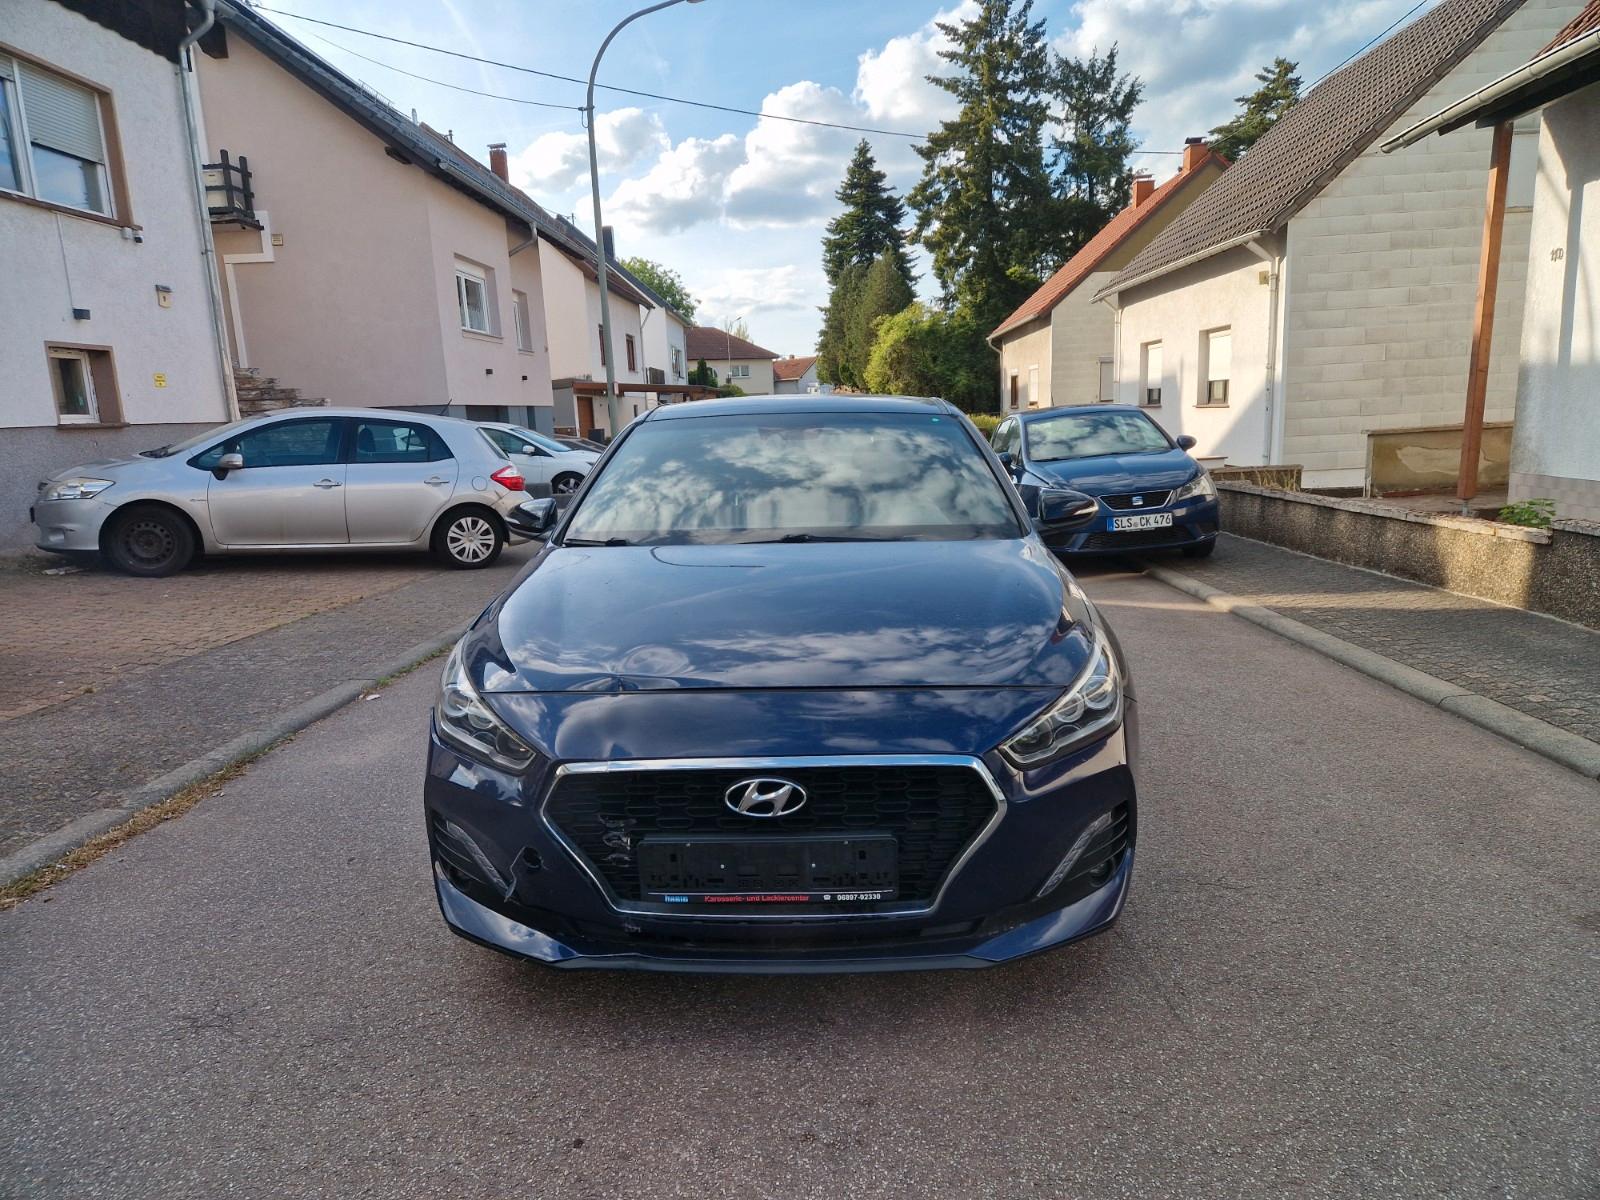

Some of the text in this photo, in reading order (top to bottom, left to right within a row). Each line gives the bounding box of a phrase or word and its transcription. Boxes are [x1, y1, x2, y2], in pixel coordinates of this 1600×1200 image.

[1114, 514, 1171, 529] SLS CK 476
